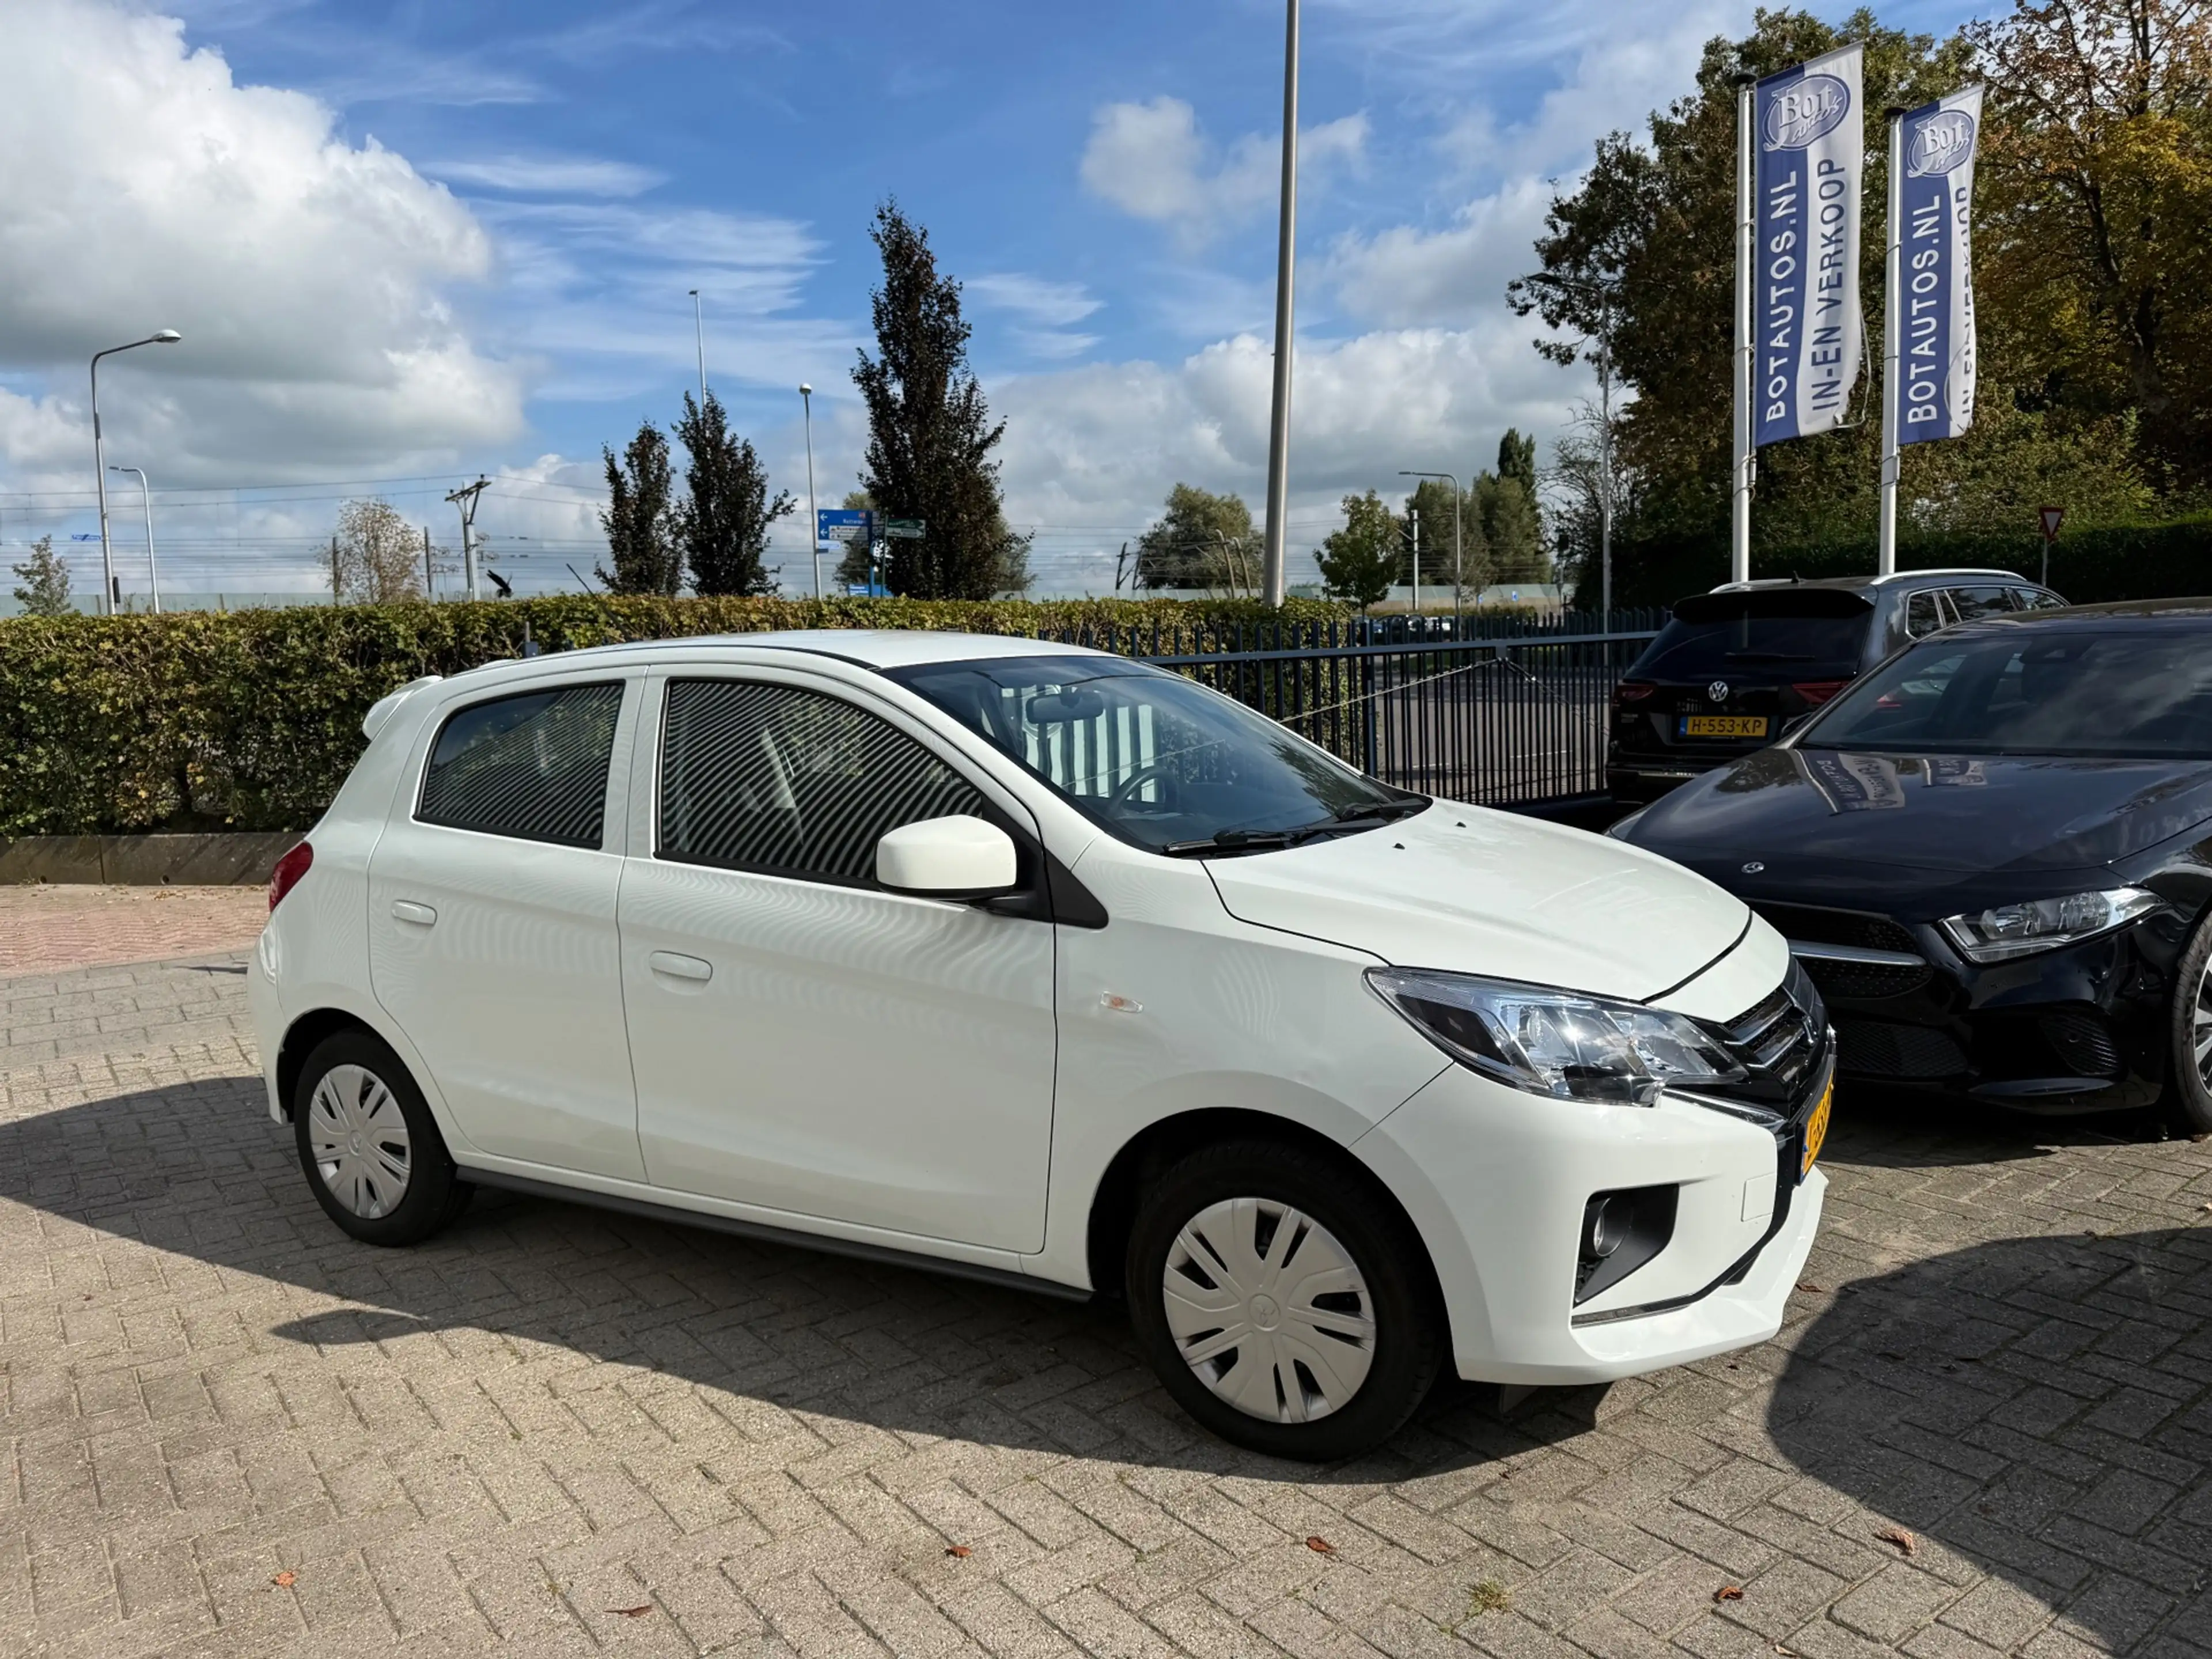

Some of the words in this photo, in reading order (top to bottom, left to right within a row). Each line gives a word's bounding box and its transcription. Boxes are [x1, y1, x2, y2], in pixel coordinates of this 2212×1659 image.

[1777, 84, 1833, 128] Bot
[1921, 119, 1965, 157] Bot
[1816, 158, 1844, 315] VERKOOP
[1766, 170, 1797, 423] BOTAUTOS.NL
[1907, 194, 1940, 424] BOTAUTOS.NL
[1811, 325, 1842, 411] IN-EN
[1691, 718, 1763, 734] H-553-KP
